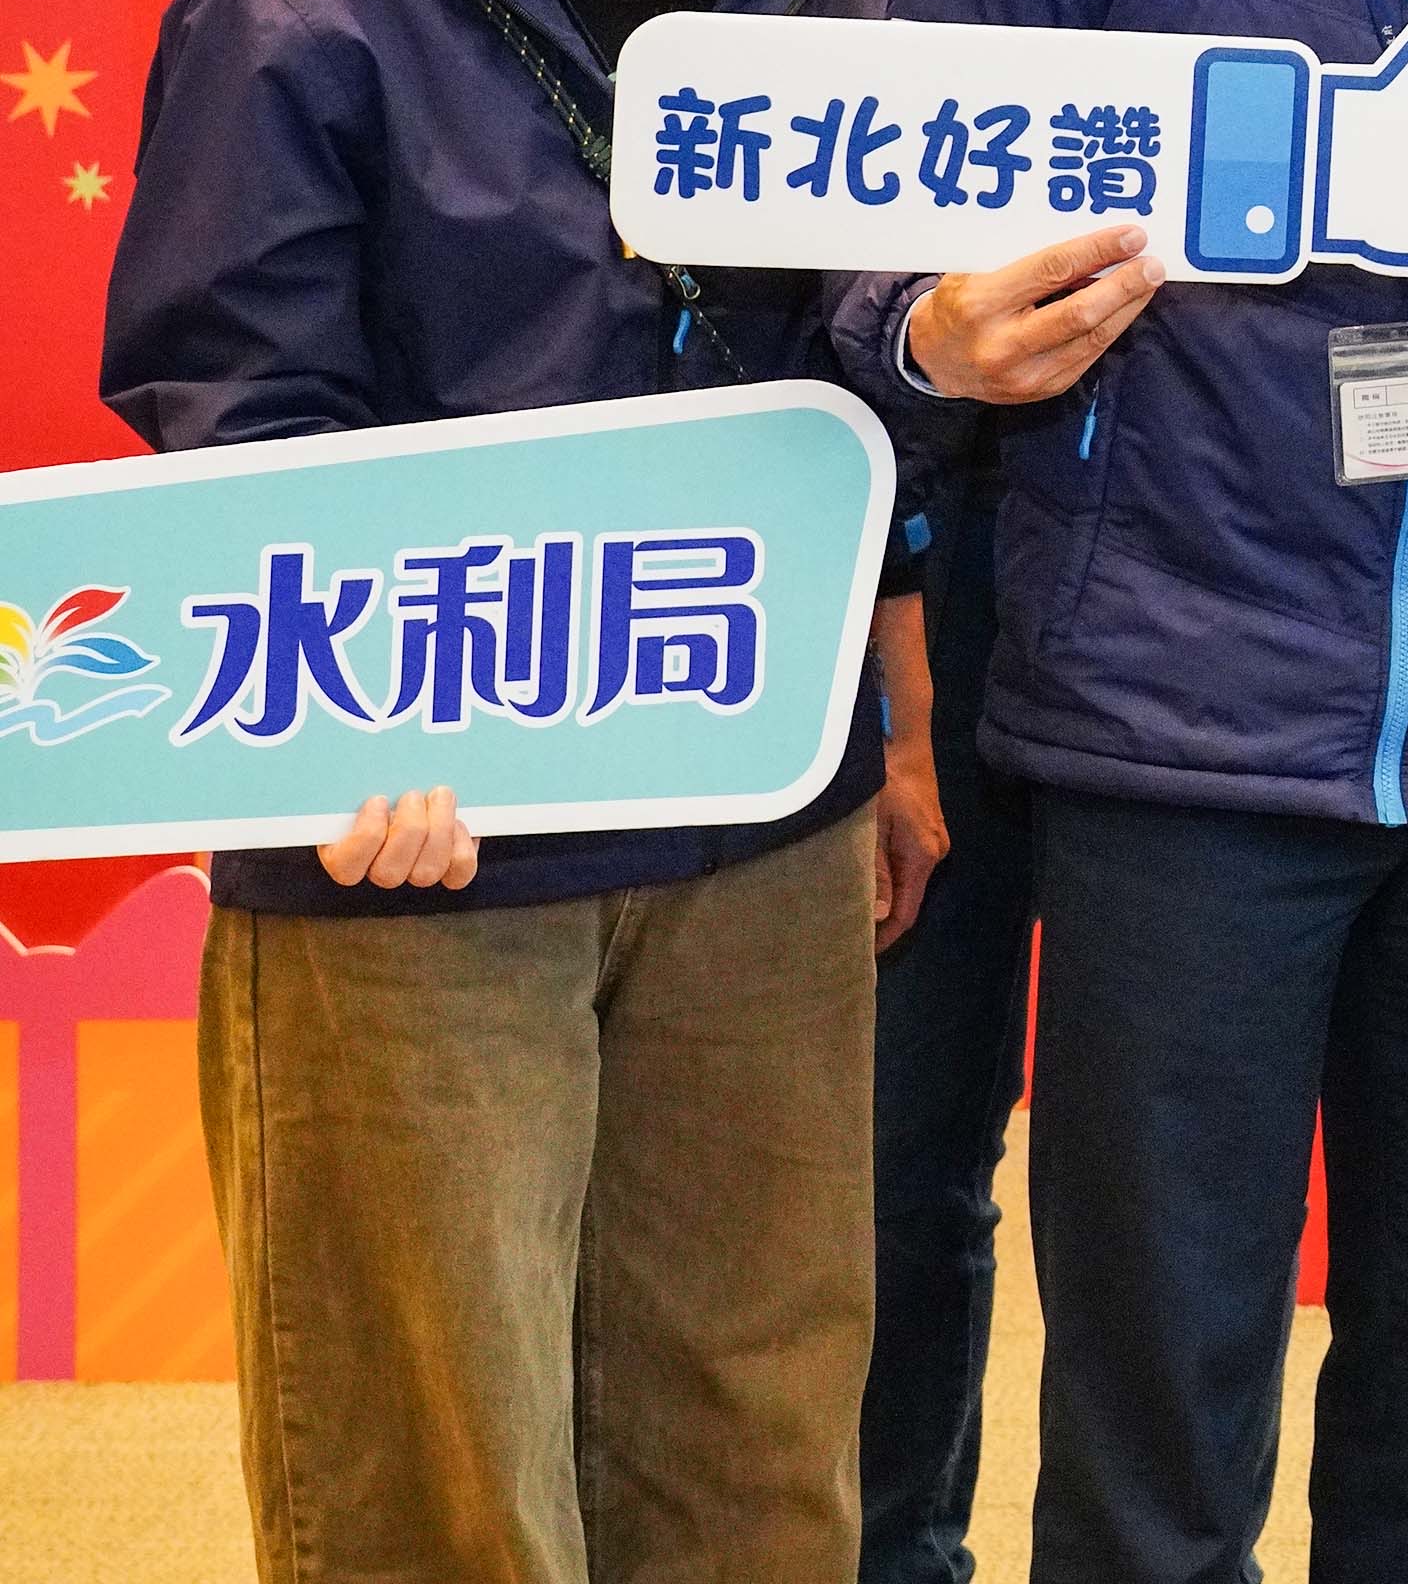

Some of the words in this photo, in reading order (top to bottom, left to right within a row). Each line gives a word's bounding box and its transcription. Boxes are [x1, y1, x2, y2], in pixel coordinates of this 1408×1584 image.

[652, 86, 1163, 216] 新北好讚
[180, 534, 764, 738] 水利局
